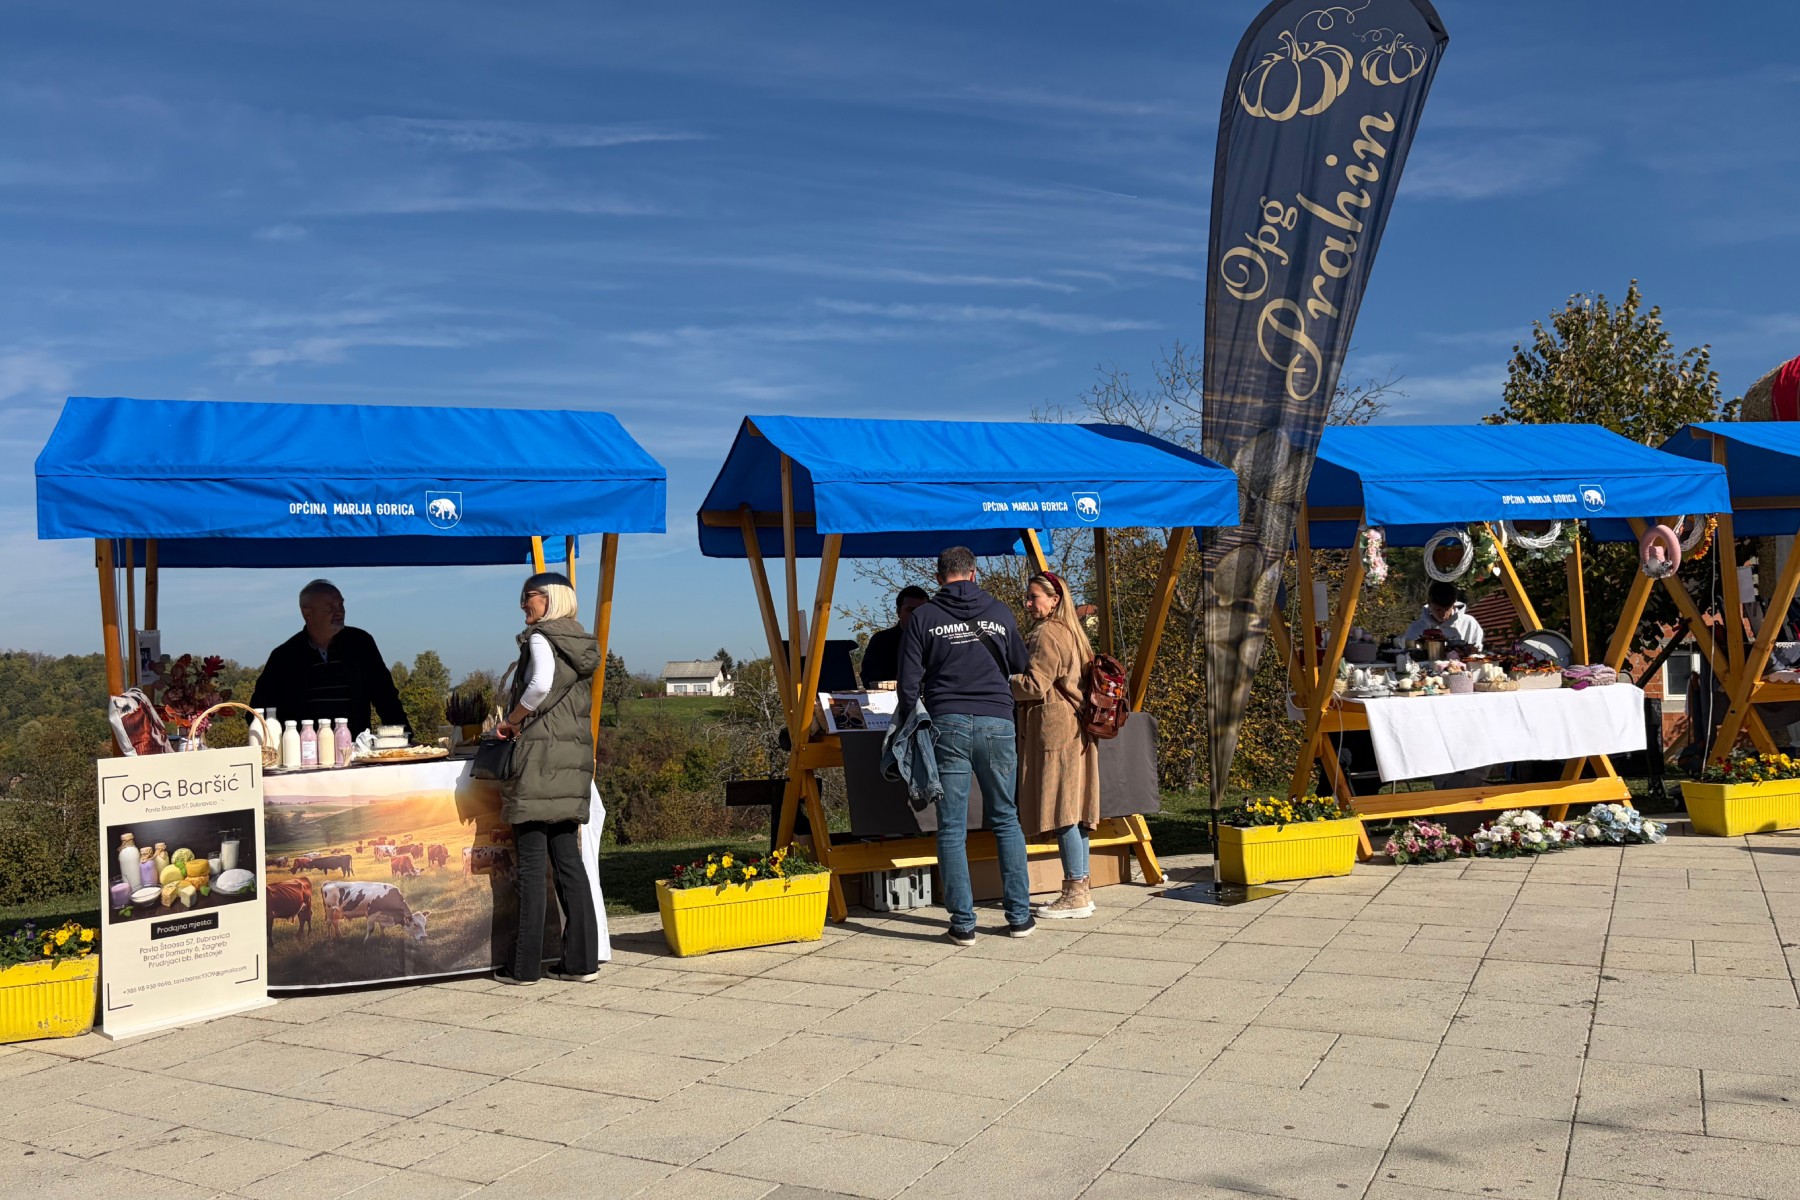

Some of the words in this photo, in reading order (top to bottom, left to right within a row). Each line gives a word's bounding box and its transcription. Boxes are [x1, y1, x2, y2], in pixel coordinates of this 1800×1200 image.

[1220, 196, 1298, 301] Opg
[1256, 110, 1396, 402] Prahin
[1553, 493, 1577, 503] GORICA
[289, 501, 327, 514] OPĆINA
[333, 503, 371, 515] MARIJA
[376, 503, 415, 515] GORICA
[1012, 501, 1039, 512] MARIJA
[1041, 501, 1068, 511] GORICA
[928, 622, 969, 637] TOMMY
[122, 780, 171, 802] OPG
[177, 773, 239, 797] Baršić
[190, 800, 217, 808] Dubravica
[156, 922, 188, 935] Prodajna
[188, 918, 214, 930] mjesta:
[139, 946, 159, 955] Pavla
[196, 932, 231, 944] Dubravica
[201, 940, 228, 951] Zagreb
[194, 949, 223, 960] Bestovje
